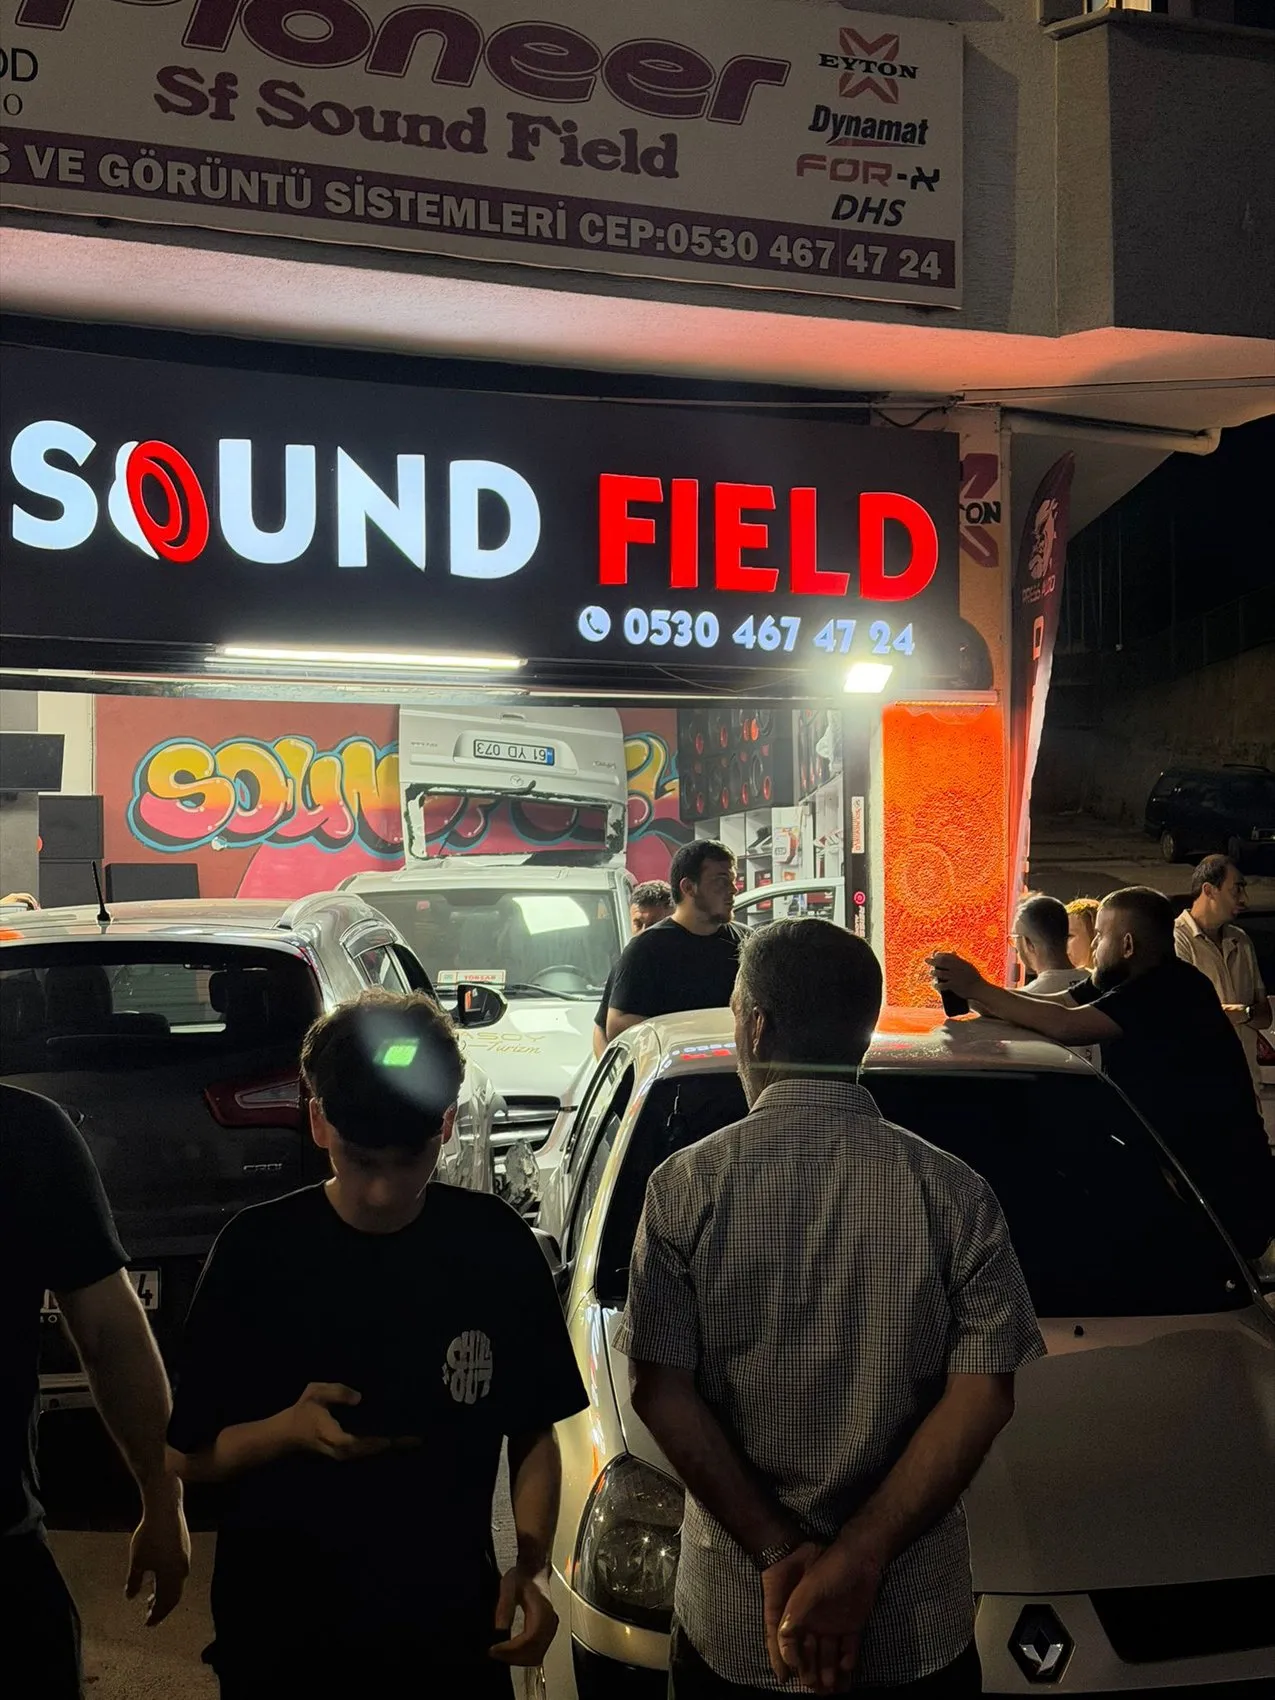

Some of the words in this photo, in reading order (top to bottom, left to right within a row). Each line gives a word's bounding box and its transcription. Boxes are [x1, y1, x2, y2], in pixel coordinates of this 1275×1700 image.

[15, 0, 791, 126] ioneer
[817, 53, 919, 80] EYTON
[153, 65, 239, 122] Sf
[256, 80, 488, 155] Sound
[506, 111, 680, 180] Field
[808, 104, 929, 147] Dynamat
[24, 143, 85, 184] VE
[99, 147, 312, 210] GÖRÜNTÜ
[324, 174, 567, 241] SİSTEMLERİ
[579, 212, 759, 262] CEP:0530
[768, 235, 836, 270] 467
[846, 244, 889, 275] 47
[899, 250, 942, 281] 24
[830, 194, 907, 227] DHS
[10, 419, 541, 580] SOUND
[599, 472, 940, 602] FIELD
[623, 606, 721, 648] 0530
[732, 613, 801, 653] 467
[813, 619, 856, 655] 47
[868, 620, 916, 657] 24
[476, 741, 501, 757] 073
[507, 745, 527, 760] YD
[533, 748, 547, 762] 61
[127, 735, 405, 858] SOUN
